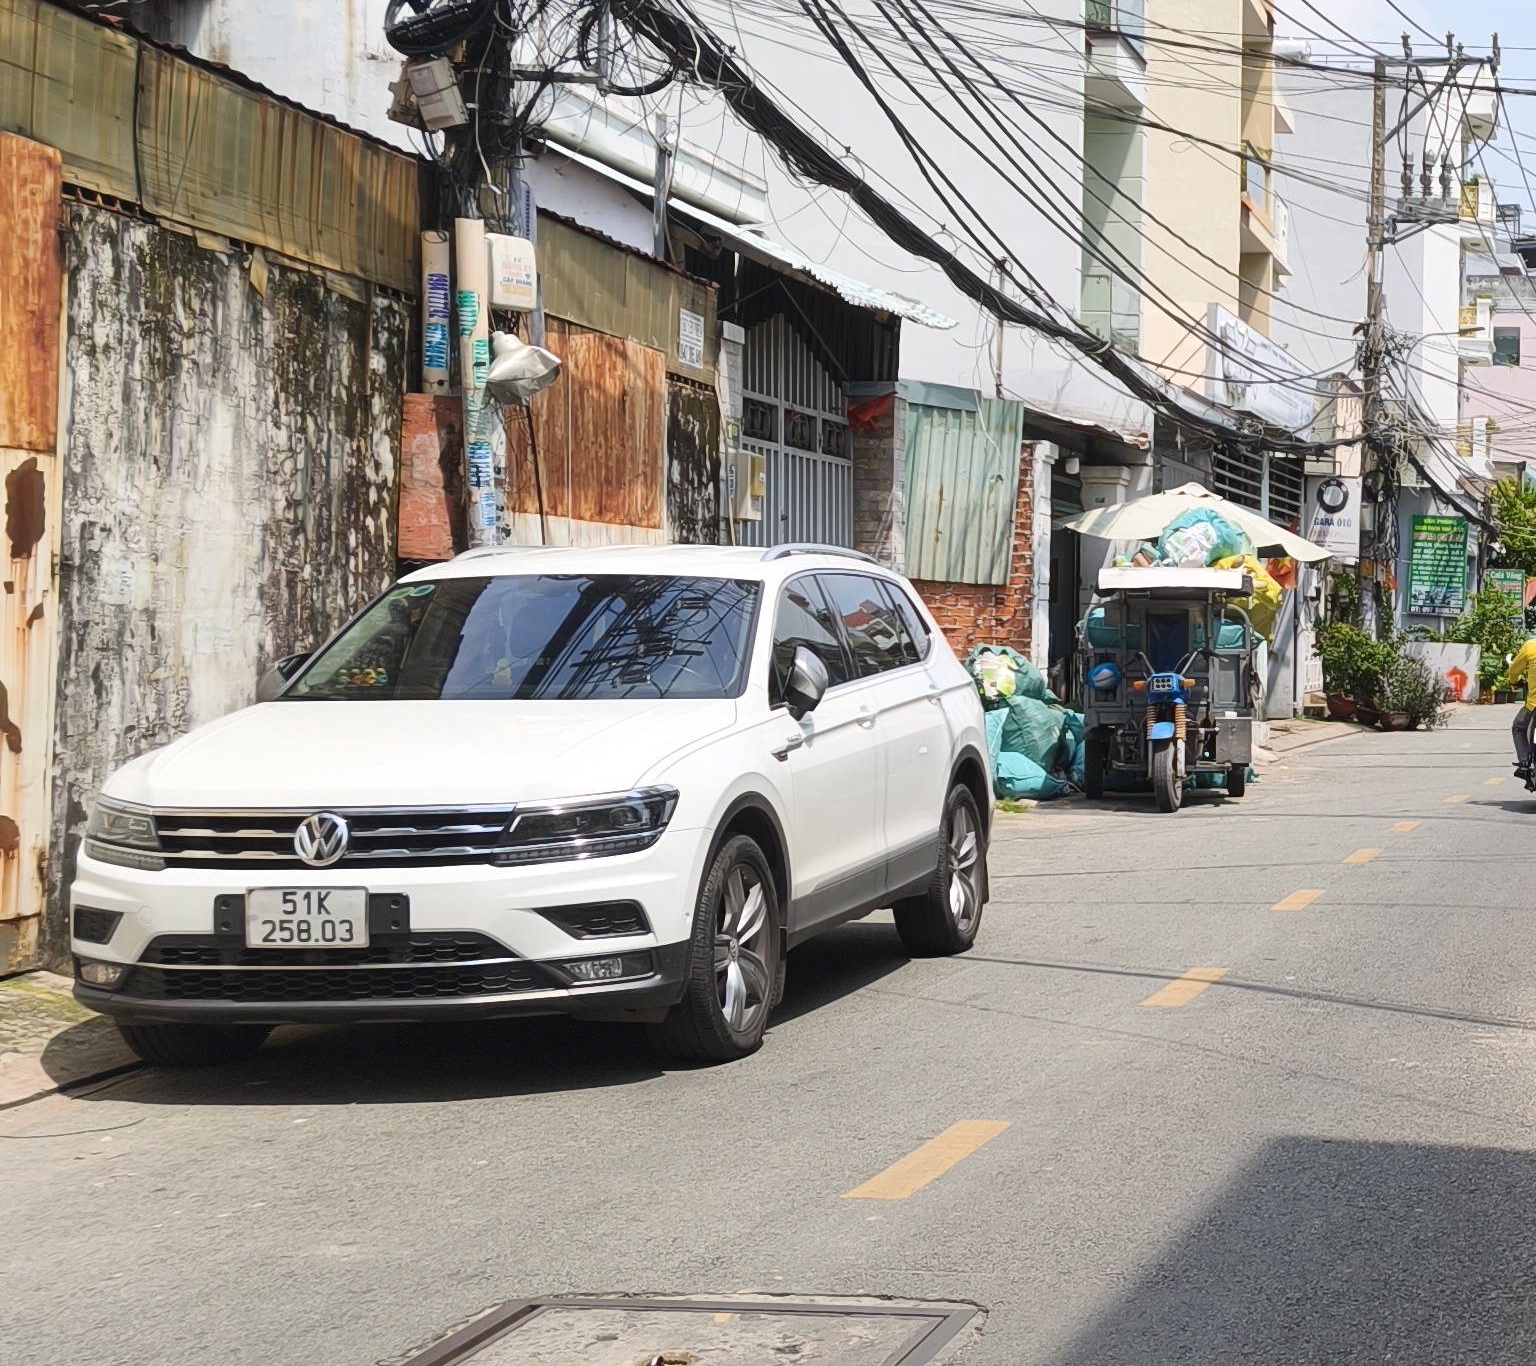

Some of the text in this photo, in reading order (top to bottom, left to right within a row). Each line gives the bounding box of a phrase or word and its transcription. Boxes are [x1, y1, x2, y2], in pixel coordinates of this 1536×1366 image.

[1314, 517, 1335, 527] GARA
[282, 891, 332, 916] 51K
[261, 919, 354, 943] 258.03
